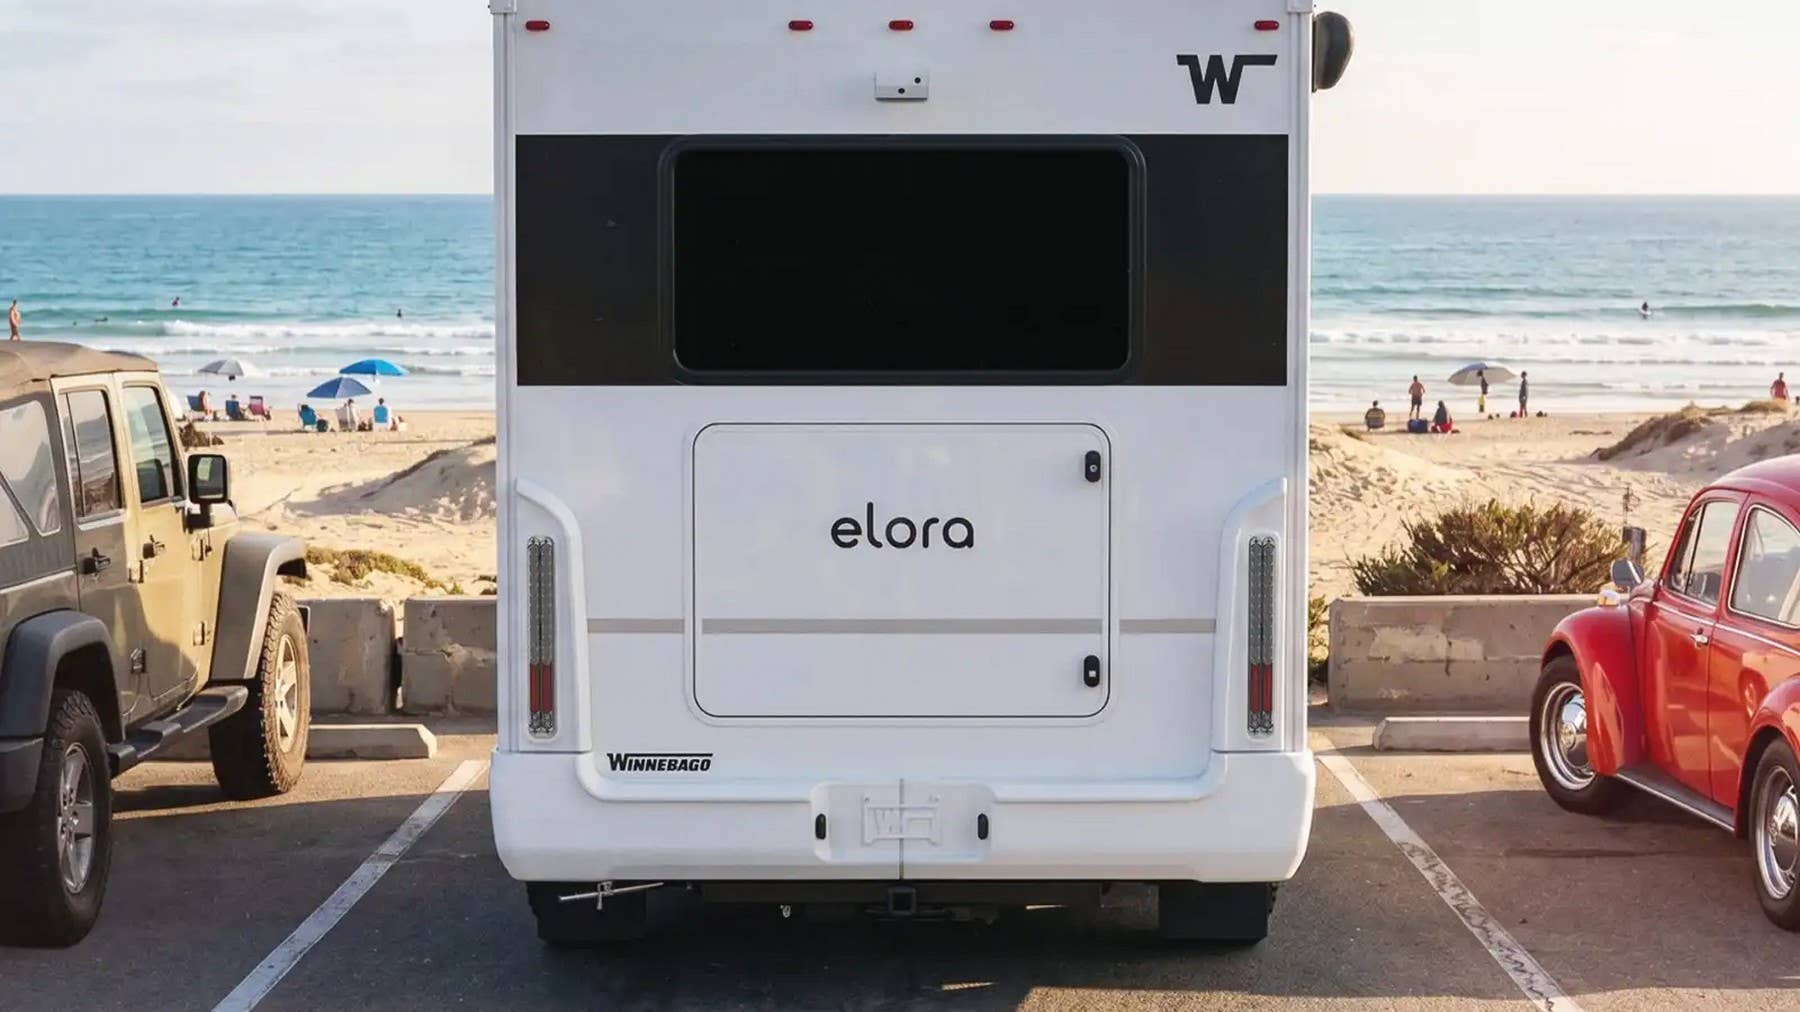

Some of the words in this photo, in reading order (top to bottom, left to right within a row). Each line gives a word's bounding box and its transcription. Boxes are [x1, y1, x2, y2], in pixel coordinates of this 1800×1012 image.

[1176, 54, 1278, 105] W
[830, 501, 975, 549] elora
[606, 753, 714, 772] WINNEBAGO
